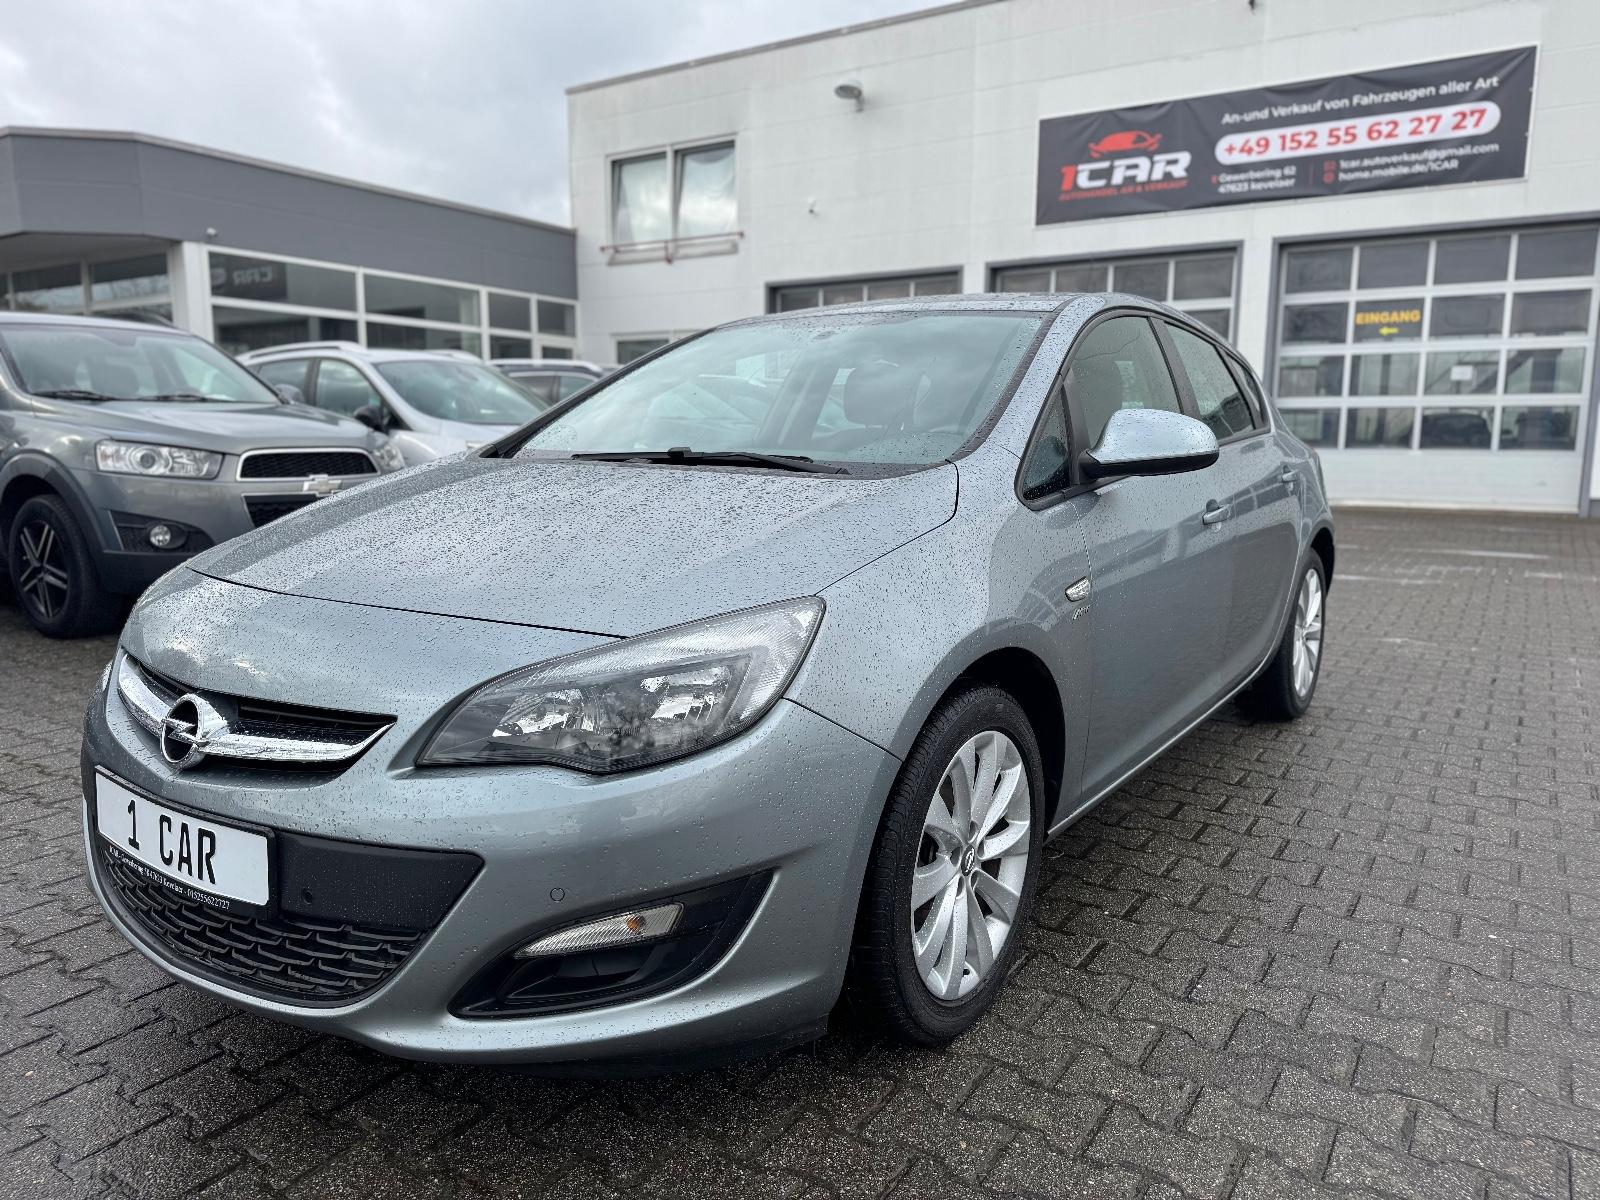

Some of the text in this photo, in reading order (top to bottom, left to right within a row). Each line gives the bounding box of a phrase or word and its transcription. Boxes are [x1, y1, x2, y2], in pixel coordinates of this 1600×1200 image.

[1221, 76, 1499, 125] An-und Verkauf von Fahrzeugen aller Art
[1224, 108, 1488, 156] +49 152 55 62 27 27
[1061, 150, 1192, 193] 1CAR
[1355, 309, 1421, 326] EINGANG
[127, 799, 216, 885] 1 CAR
